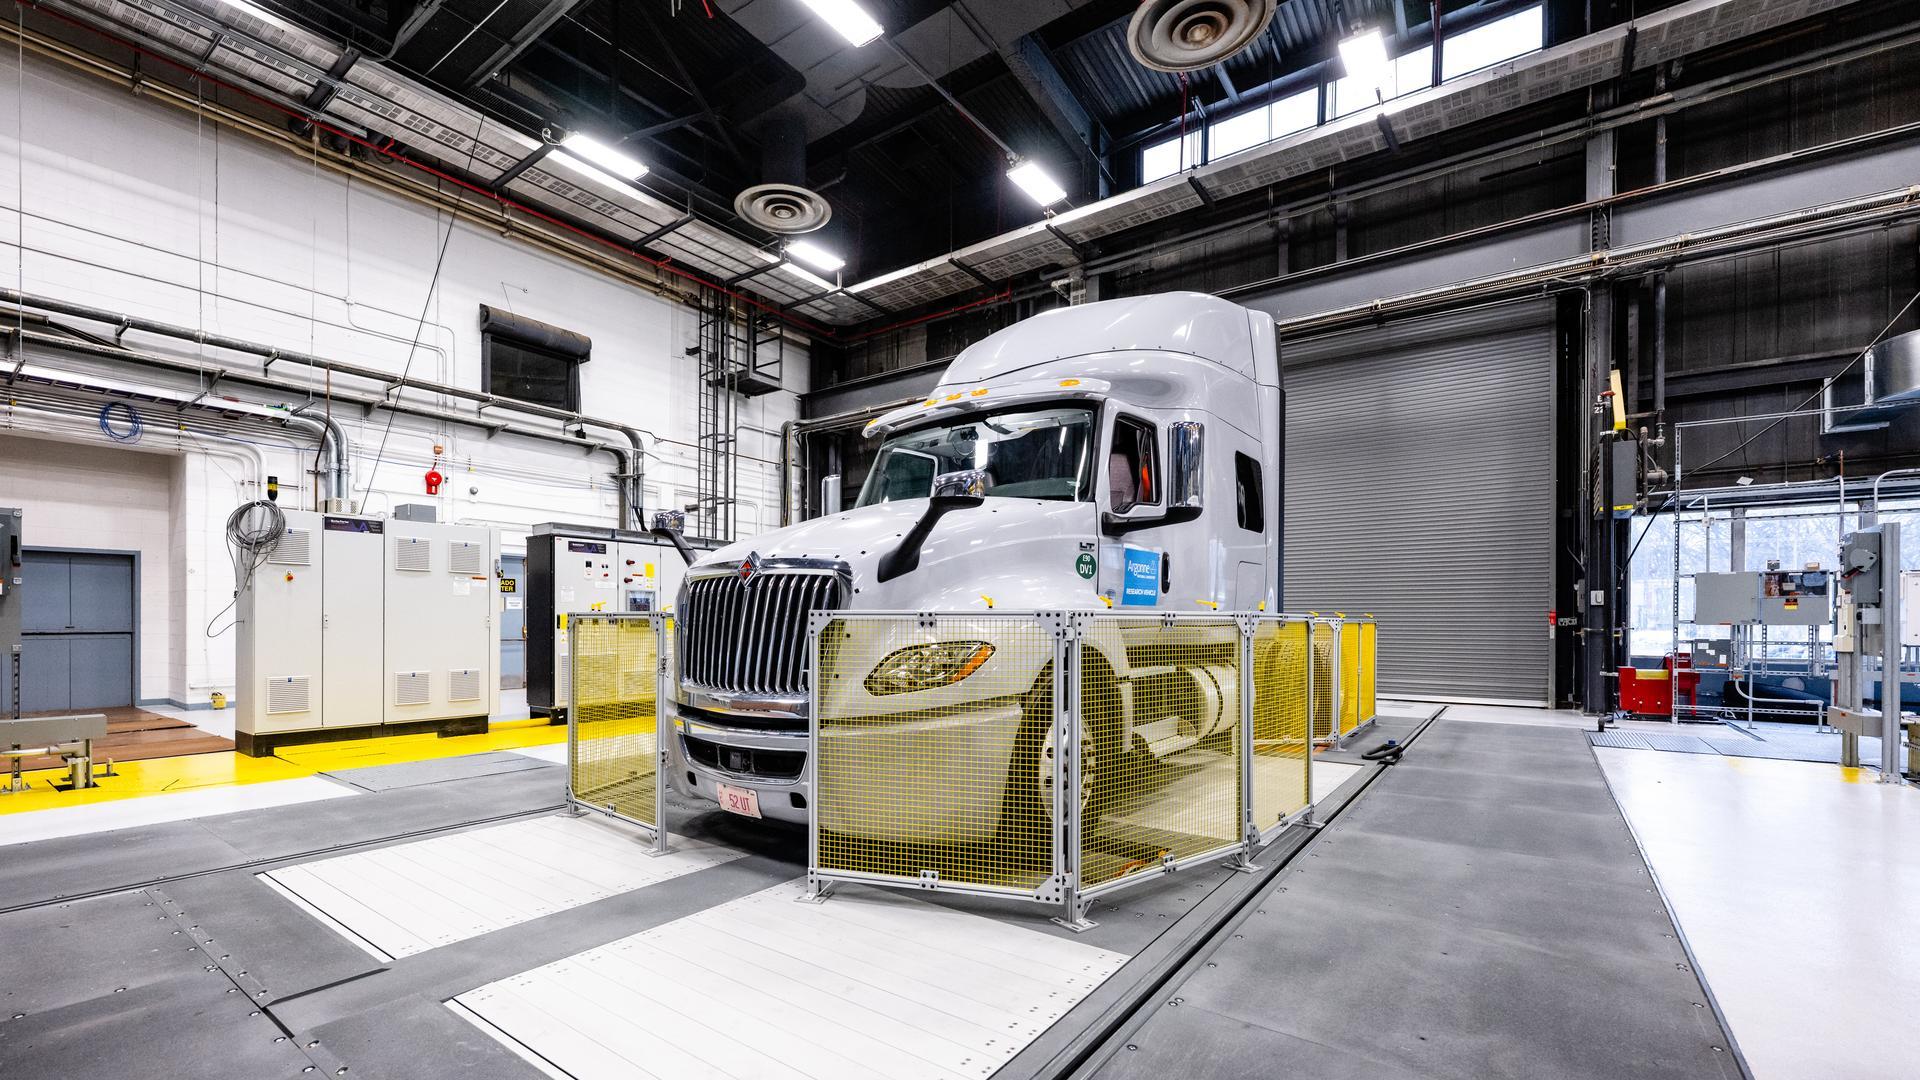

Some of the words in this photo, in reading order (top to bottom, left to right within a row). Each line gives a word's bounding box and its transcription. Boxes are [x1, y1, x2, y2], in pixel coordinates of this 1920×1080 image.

[1080, 563, 1092, 574] DV1
[1128, 560, 1150, 576] Argonne
[728, 793, 740, 809] 52
